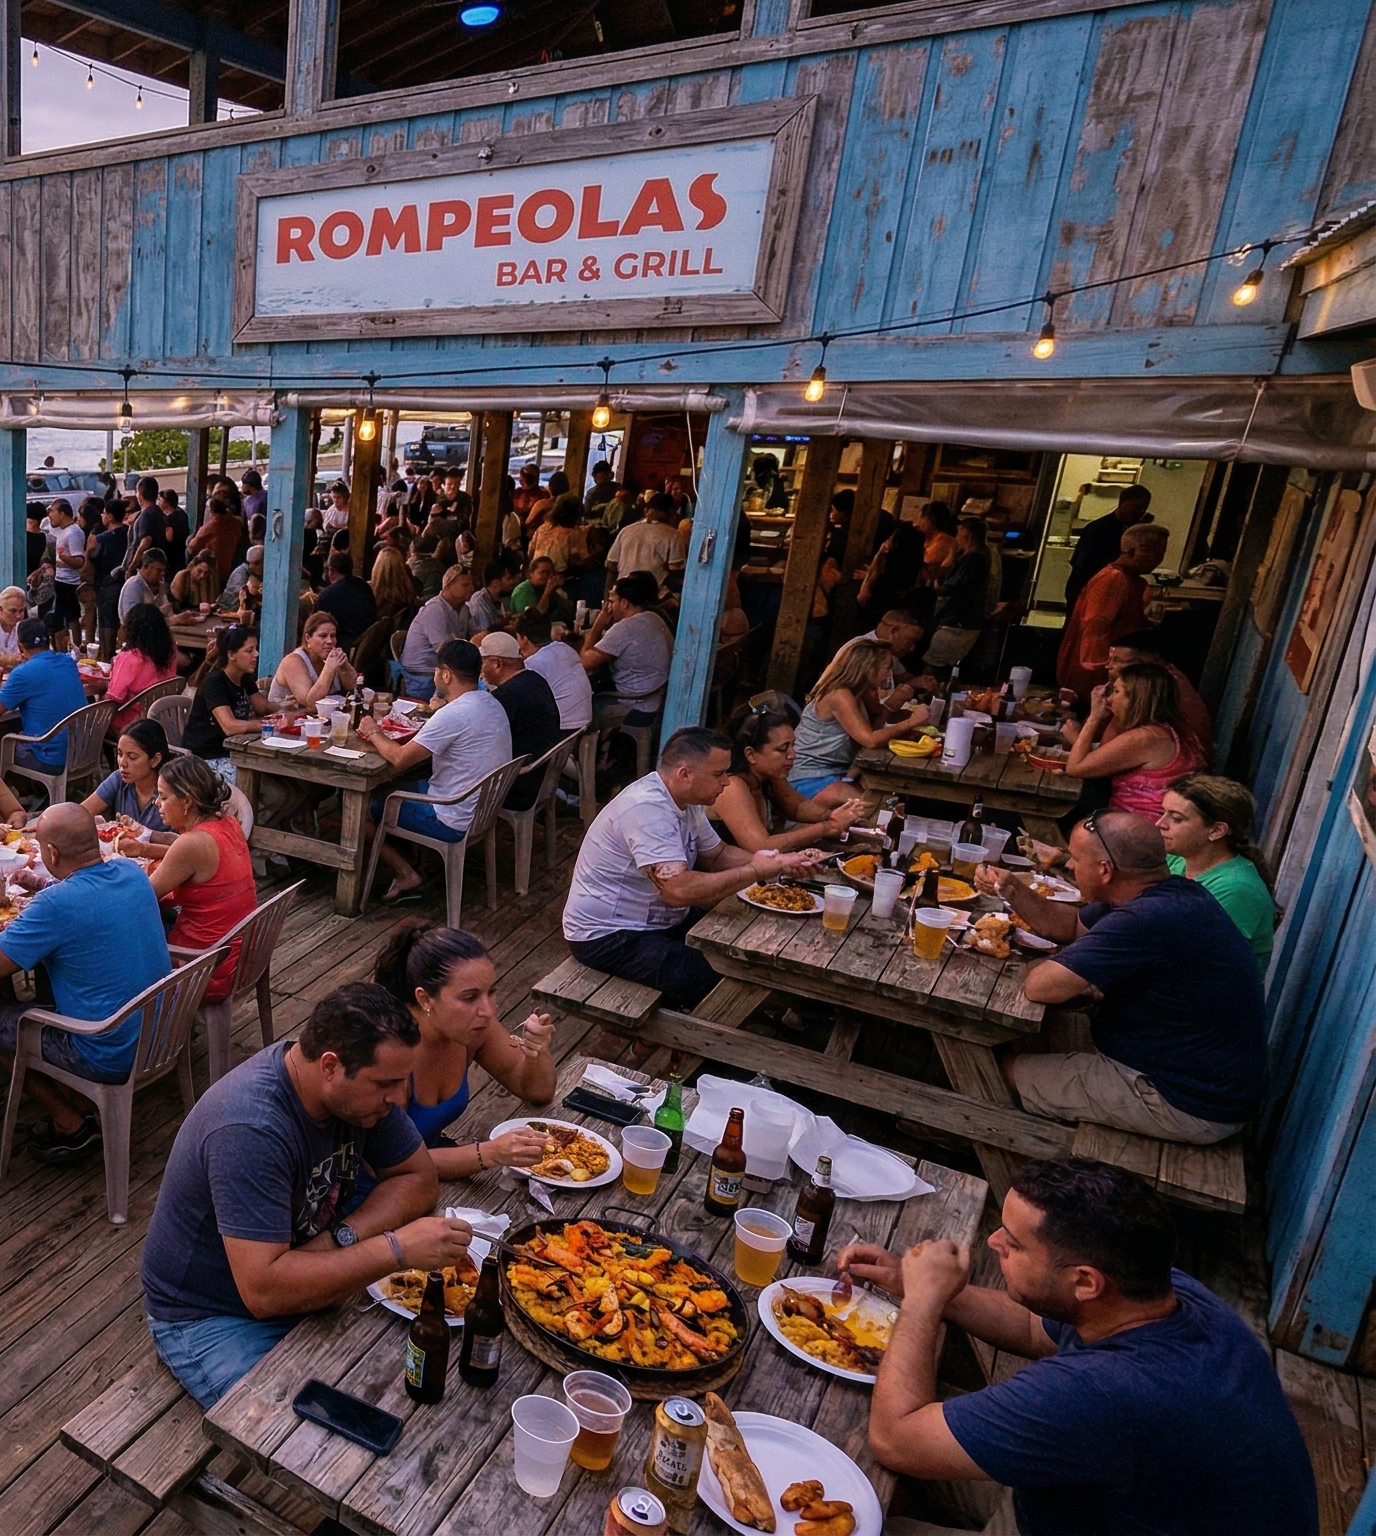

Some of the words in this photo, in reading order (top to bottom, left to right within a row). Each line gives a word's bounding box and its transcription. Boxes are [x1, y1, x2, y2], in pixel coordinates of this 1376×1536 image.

[276, 173, 728, 264] ROMPEOLAS
[496, 258, 568, 287] BAR
[578, 255, 601, 282] &
[614, 249, 723, 280] GRILL
